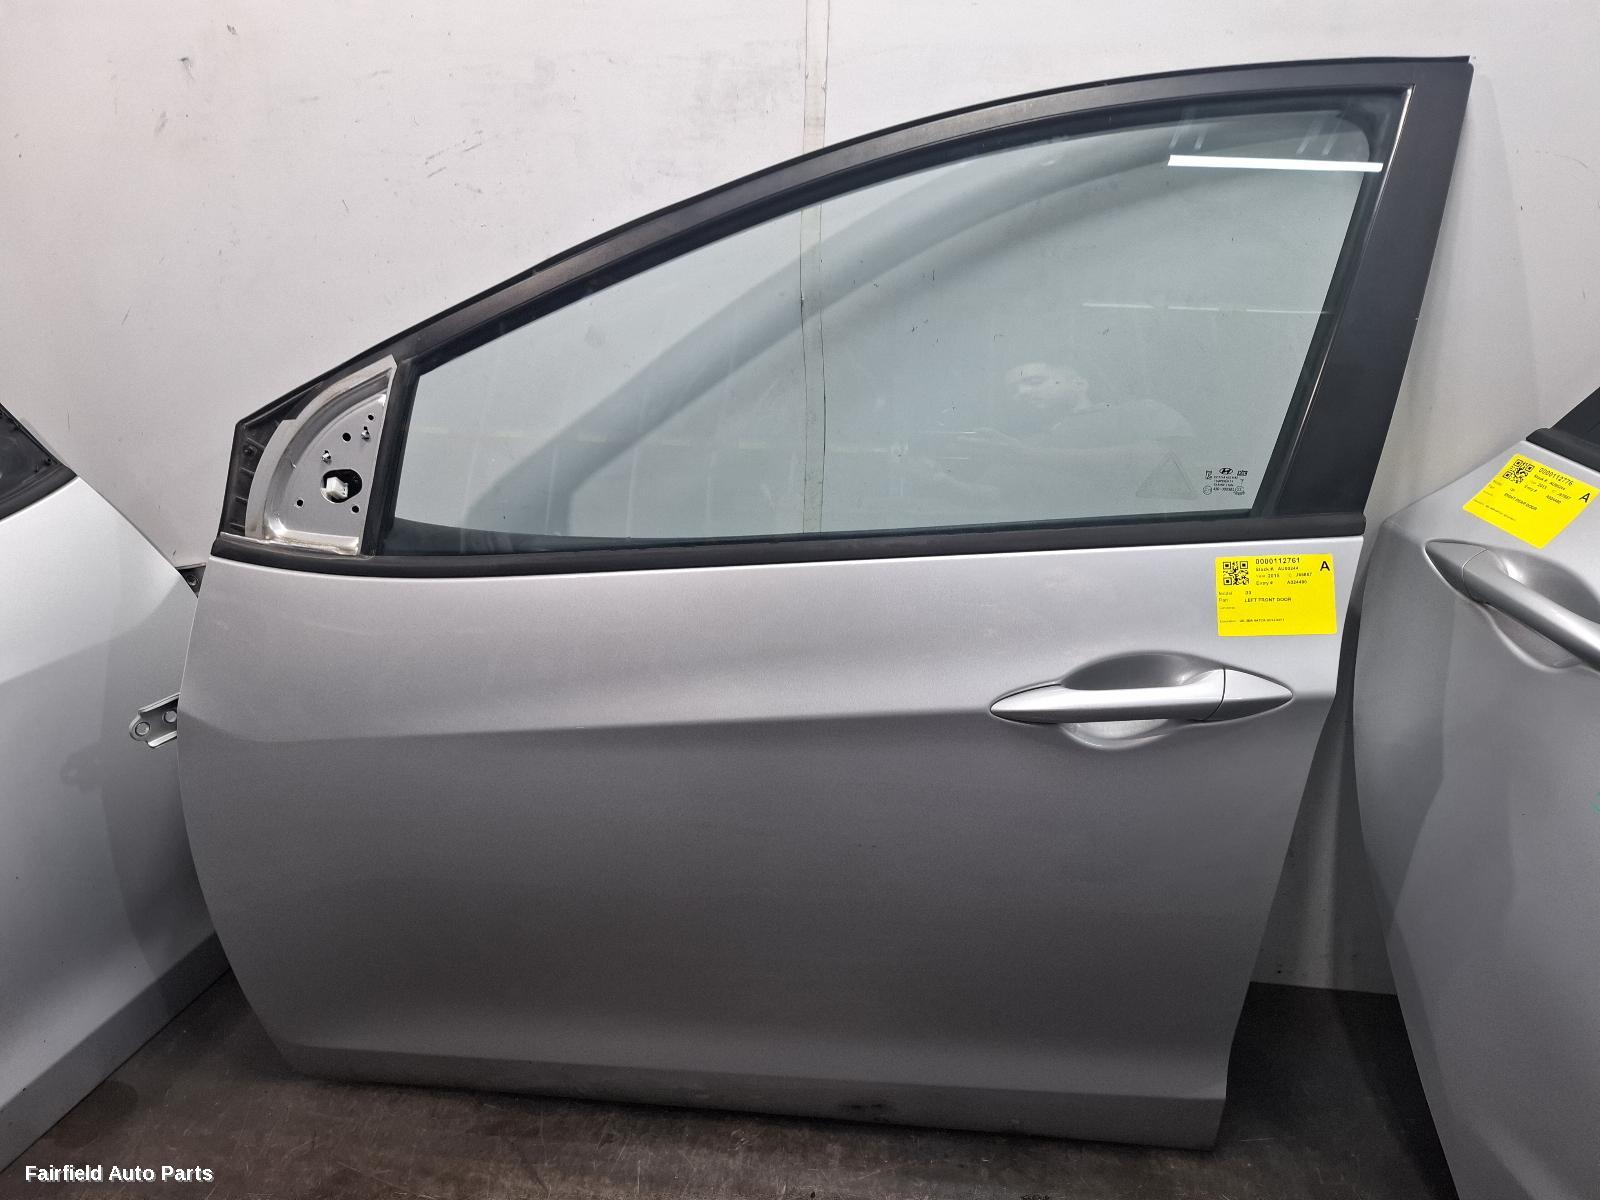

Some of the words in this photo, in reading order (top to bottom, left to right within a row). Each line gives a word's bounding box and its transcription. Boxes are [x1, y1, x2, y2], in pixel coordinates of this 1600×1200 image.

[1539, 468, 1574, 486] 0000112776
[1579, 493, 1590, 503] A
[1320, 561, 1331, 571] A
